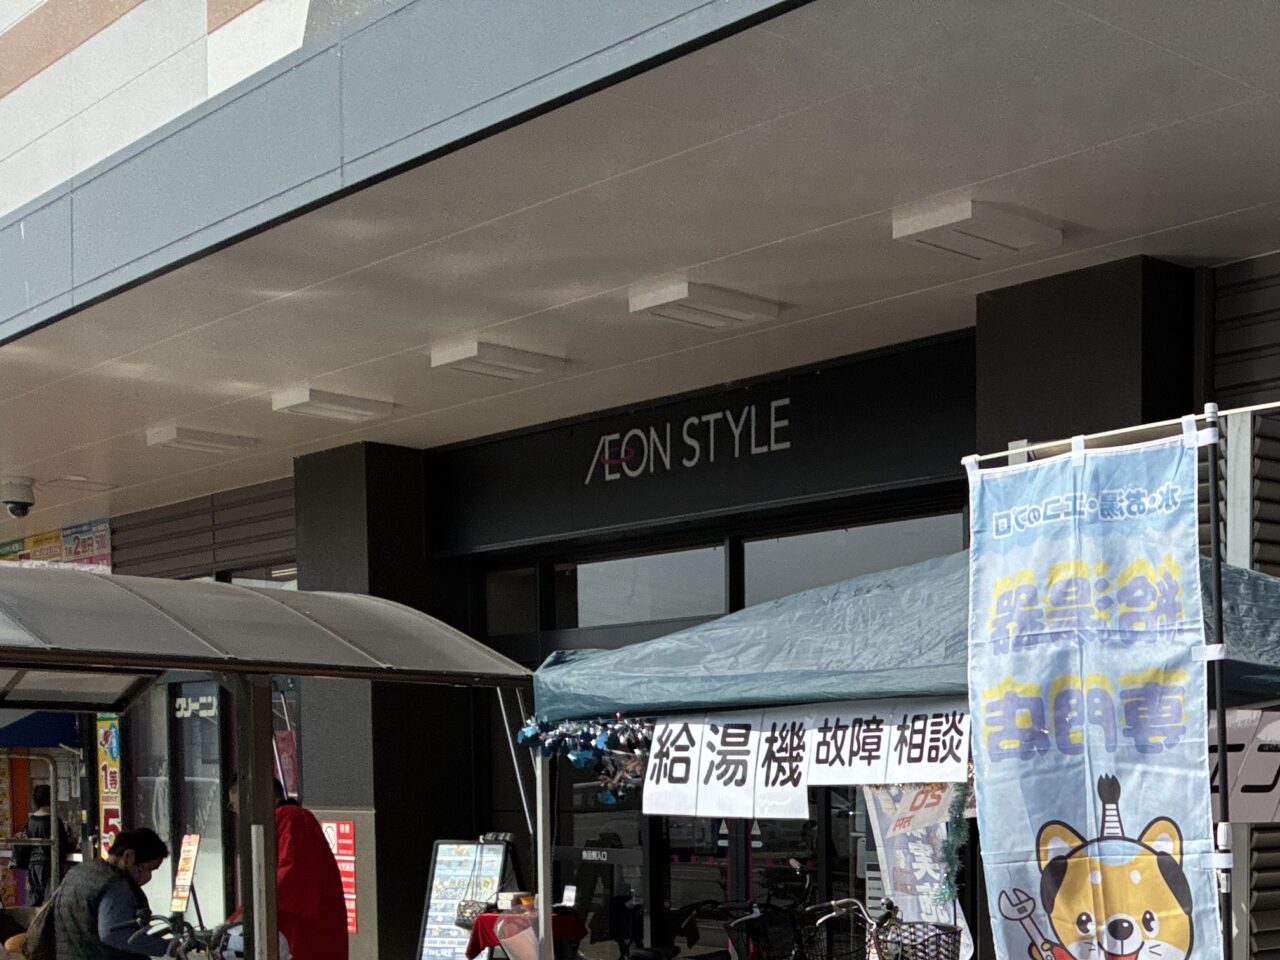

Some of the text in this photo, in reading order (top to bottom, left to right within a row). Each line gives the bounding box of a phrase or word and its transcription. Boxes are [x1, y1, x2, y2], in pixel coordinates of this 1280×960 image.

[682, 397, 792, 468] STYLE
[175, 695, 218, 718] クリーニン
